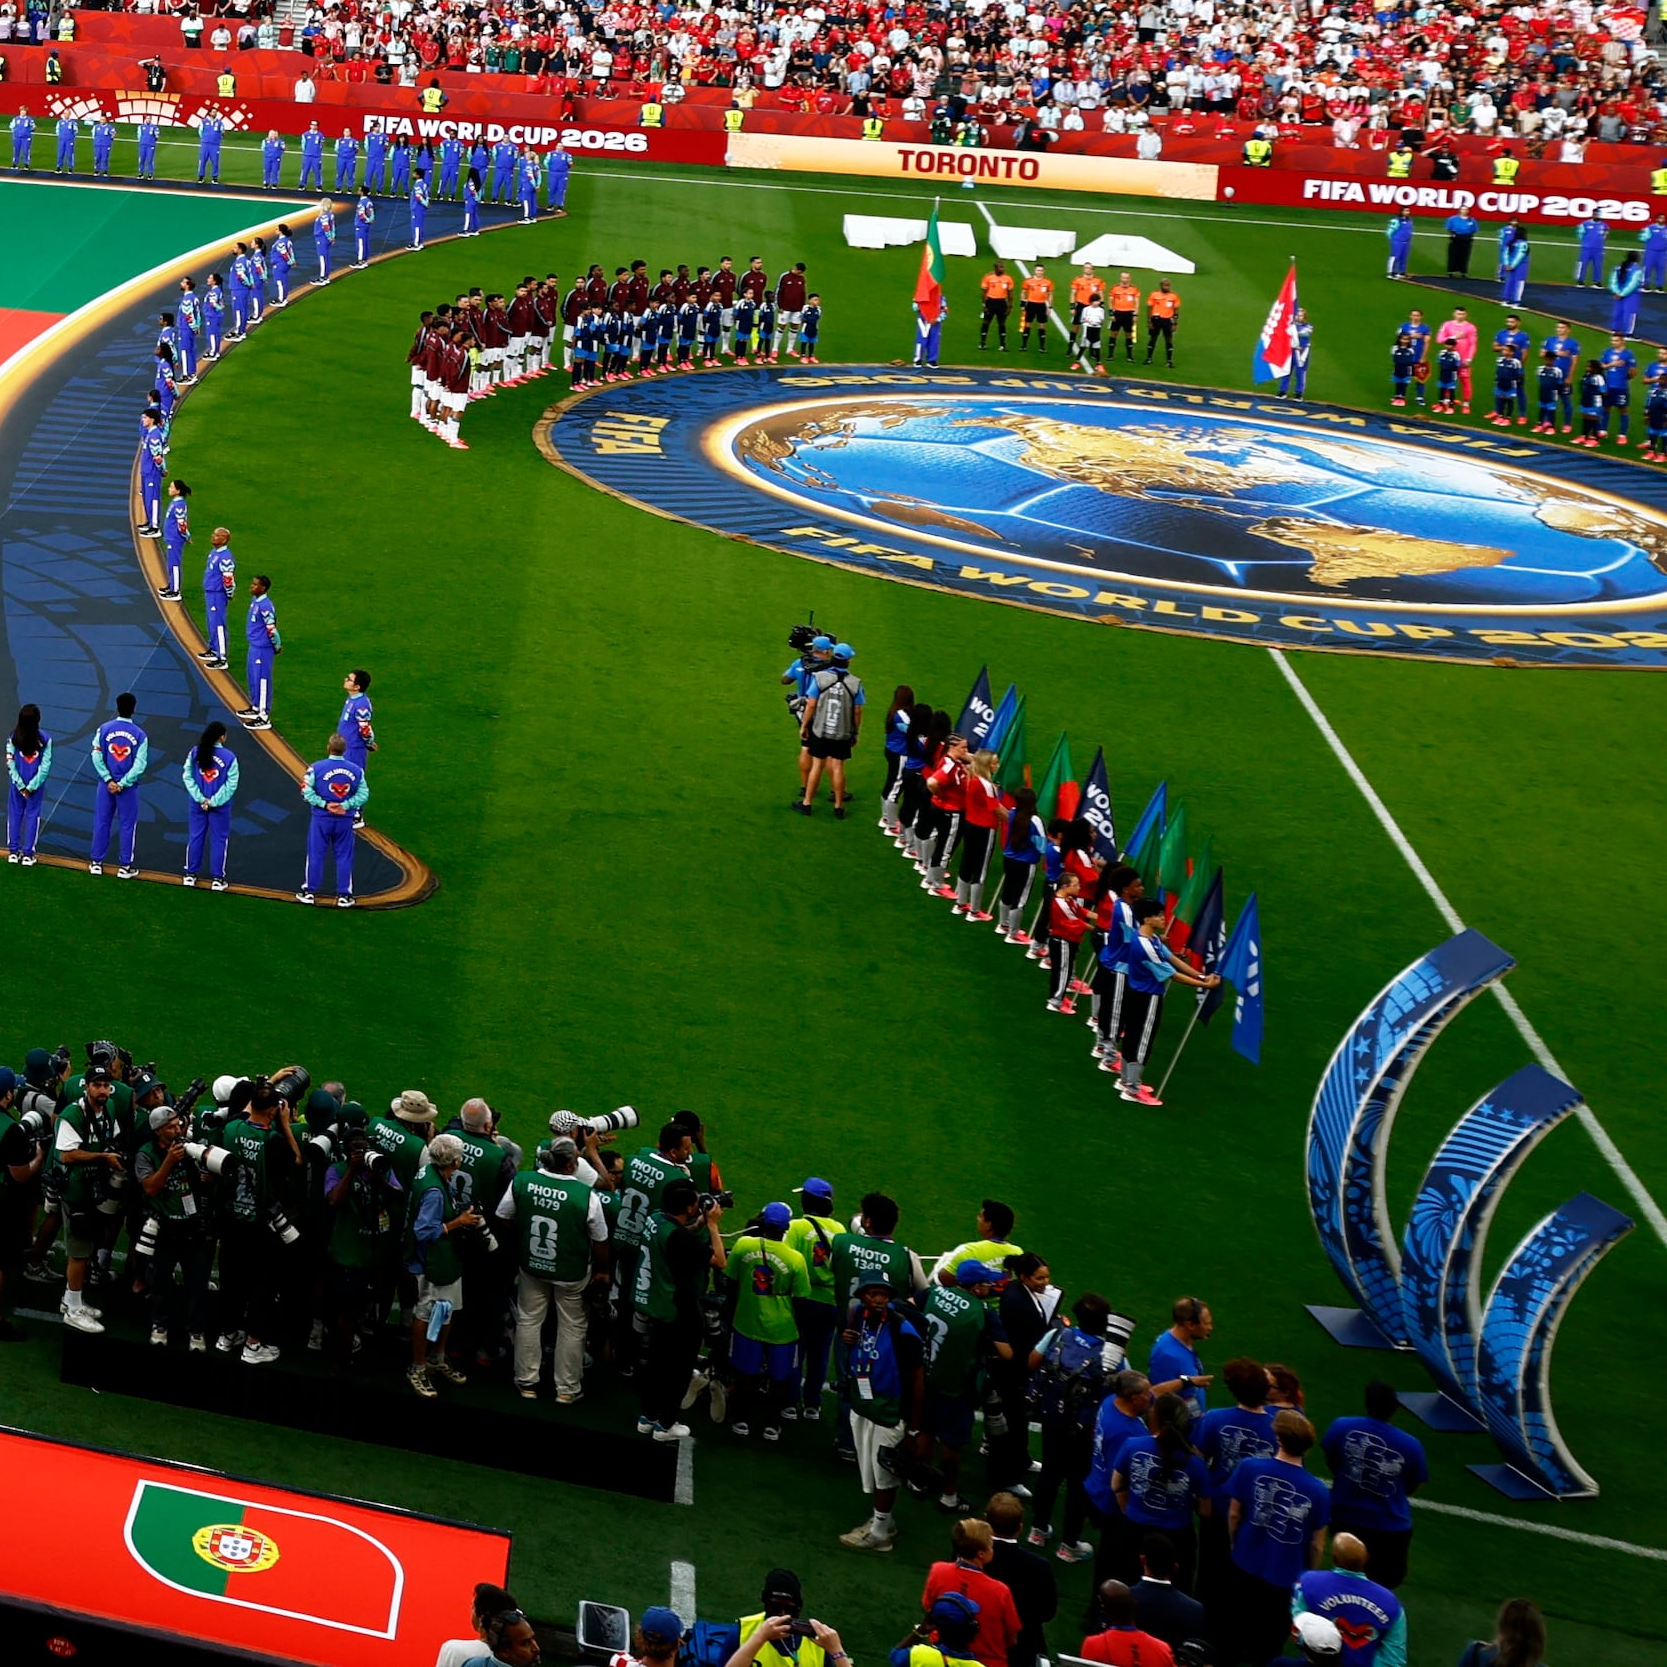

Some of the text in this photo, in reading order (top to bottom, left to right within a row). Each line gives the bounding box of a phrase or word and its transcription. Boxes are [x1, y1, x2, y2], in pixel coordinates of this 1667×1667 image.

[363, 114, 648, 152] FIFA WORLD CUP 2026
[897, 149, 1040, 181] TORONTO
[1303, 179, 1651, 222] FIFA WORLD CUP 2026
[590, 410, 670, 454] FIFA
[780, 525, 1667, 649] FIFA WORLD CUP 202
[374, 1122, 405, 1146] PHOTO
[461, 1143, 483, 1158] OTO
[630, 1158, 665, 1181] PHOTO
[527, 1183, 568, 1201] PHOTO
[532, 1196, 561, 1211] 1479
[849, 1243, 891, 1264] PHOTO
[934, 1285, 971, 1311] PHOTO
[934, 1296, 960, 1317] 1492
[1319, 1592, 1390, 1625] VOLUNTEER
